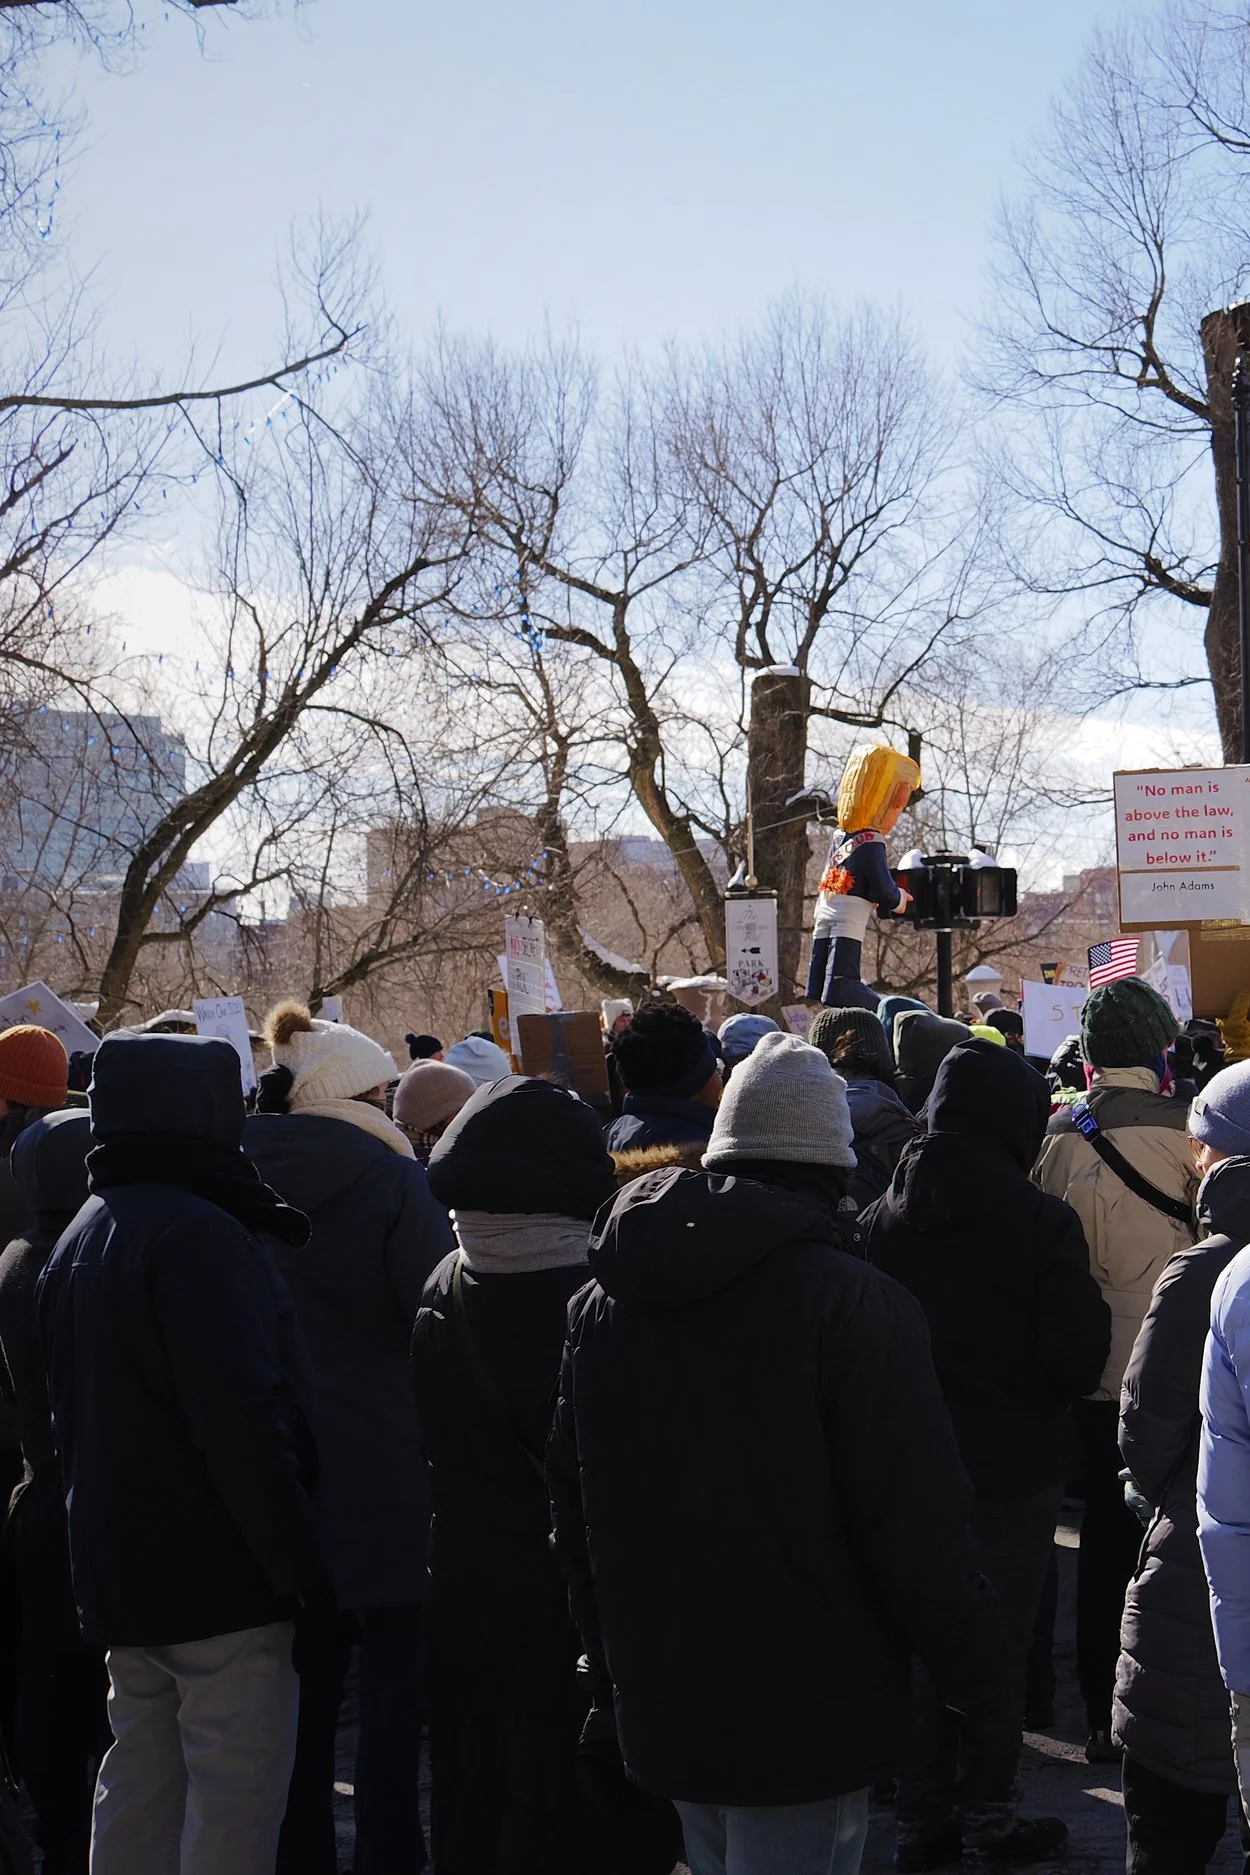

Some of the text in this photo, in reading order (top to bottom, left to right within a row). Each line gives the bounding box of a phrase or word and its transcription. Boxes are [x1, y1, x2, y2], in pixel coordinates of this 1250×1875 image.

[1171, 784, 1203, 796] man
[1208, 781, 1220, 793] is
[1125, 805, 1234, 822] above the law,
[1128, 826, 1233, 842] and no man is
[1146, 852, 1191, 864] below
[1151, 880, 1215, 892] John Adams
[737, 960, 764, 968] PARK
